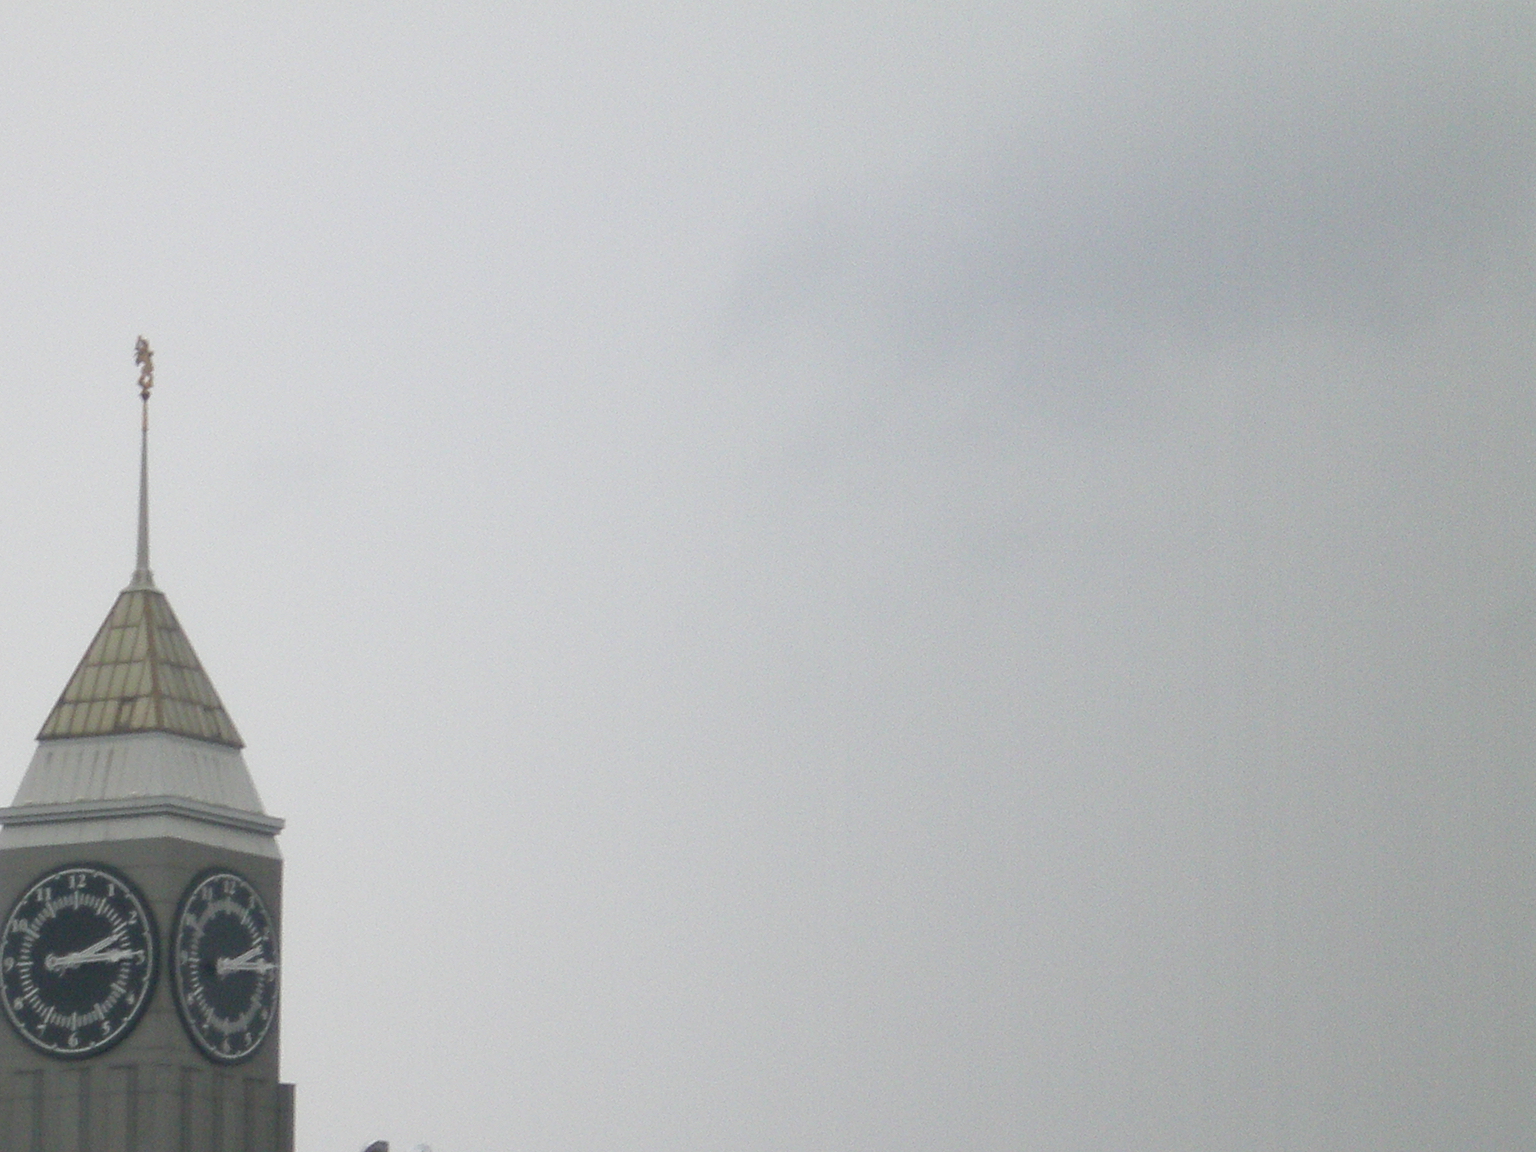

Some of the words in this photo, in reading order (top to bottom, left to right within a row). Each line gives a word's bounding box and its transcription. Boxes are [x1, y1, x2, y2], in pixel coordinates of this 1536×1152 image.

[68, 874, 86, 889] 12
[37, 887, 51, 901] 11
[108, 884, 115, 897] 1
[128, 911, 137, 925] 2
[4, 957, 14, 972] 9
[102, 1021, 111, 1035] 5
[68, 1032, 78, 1047] 6
